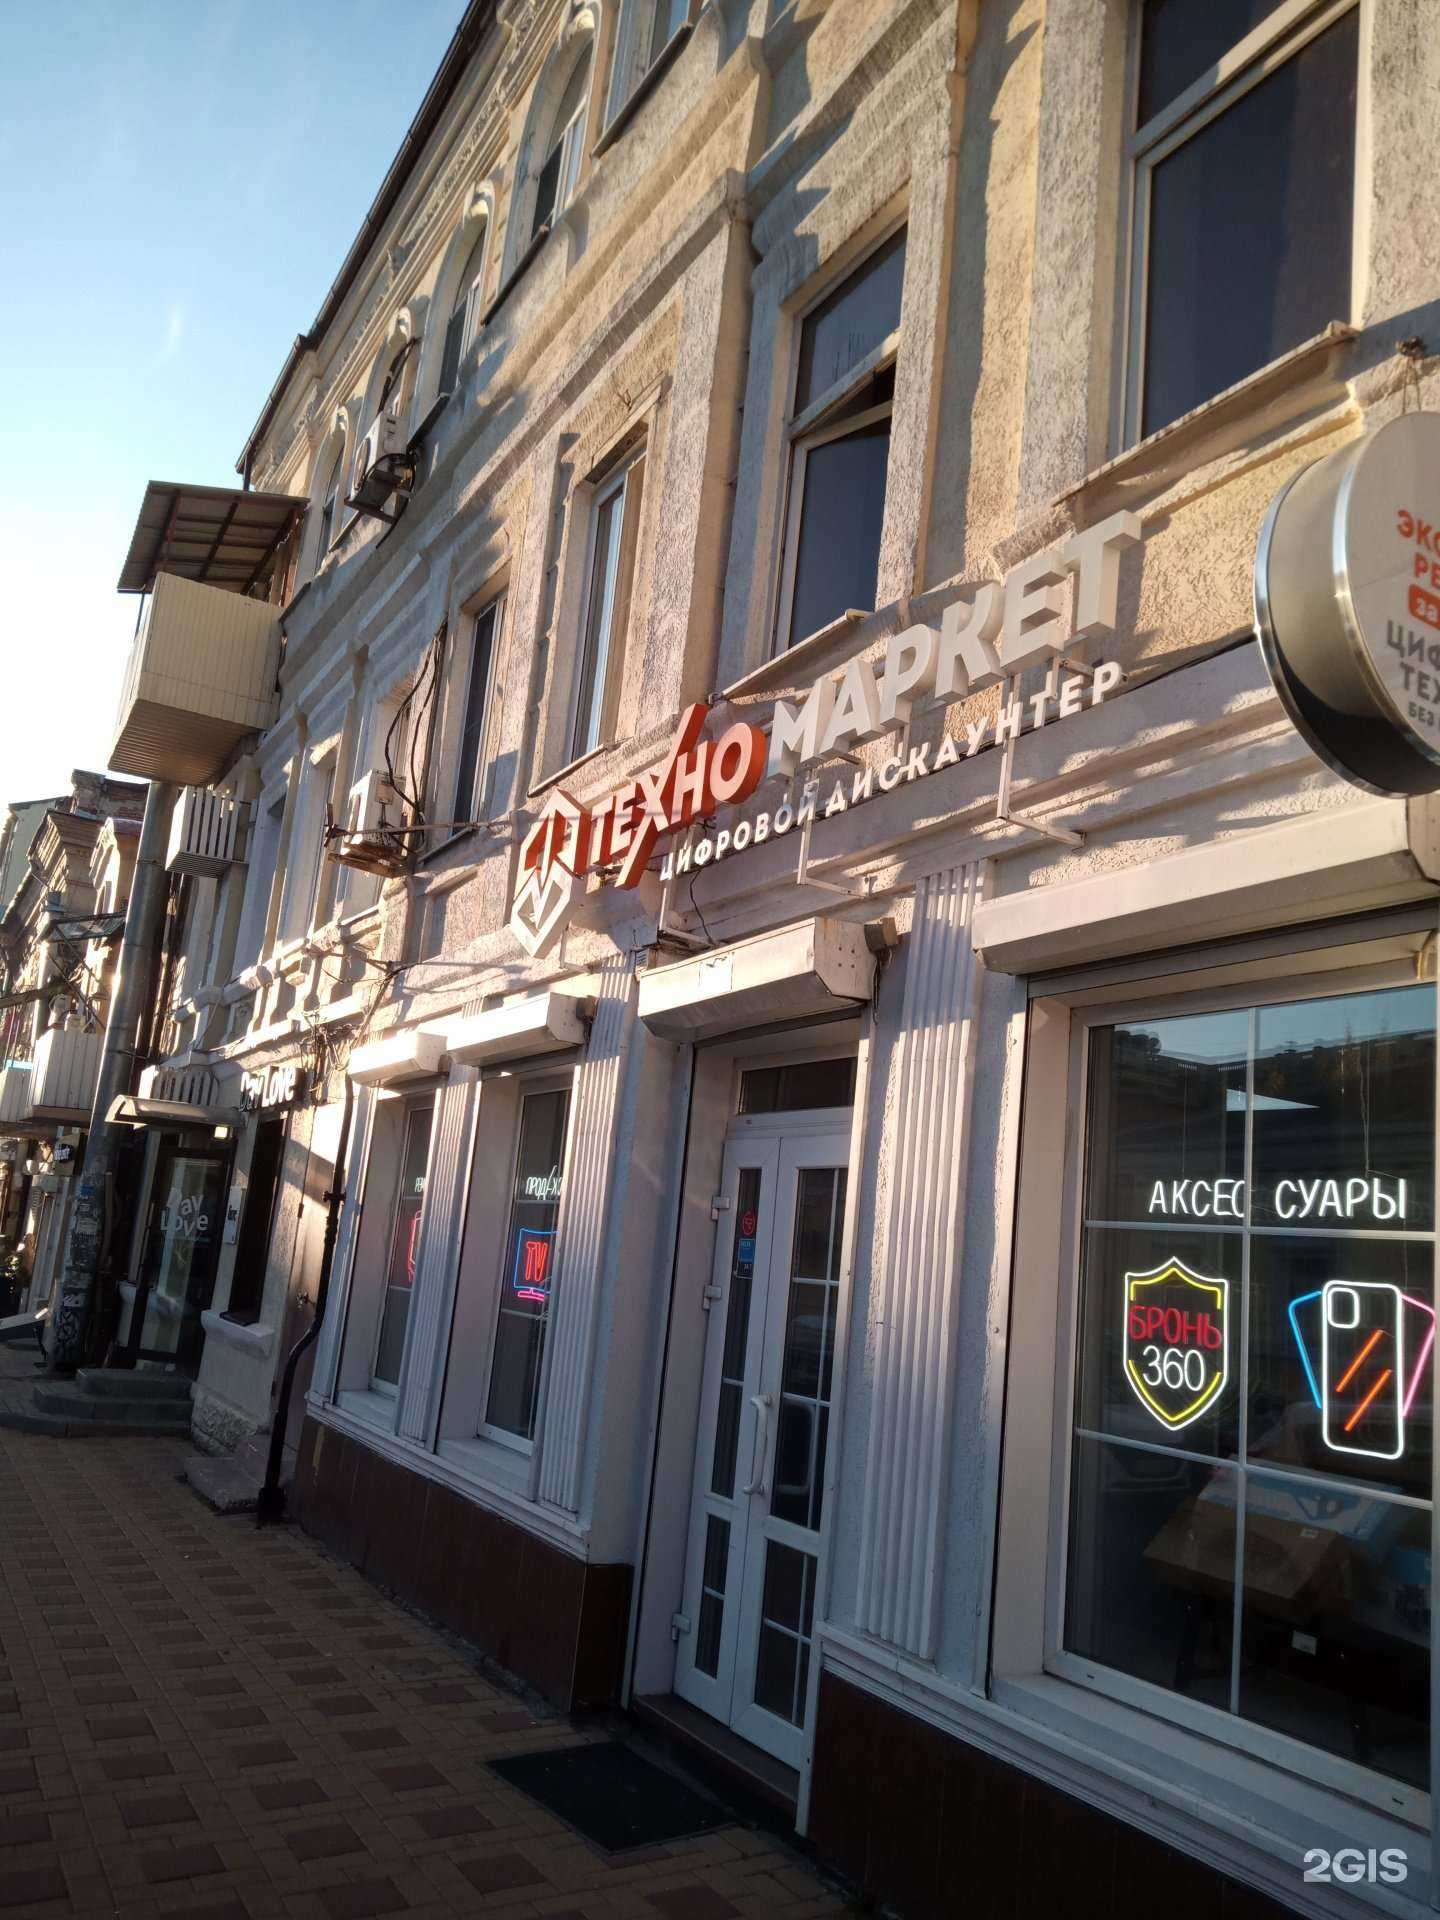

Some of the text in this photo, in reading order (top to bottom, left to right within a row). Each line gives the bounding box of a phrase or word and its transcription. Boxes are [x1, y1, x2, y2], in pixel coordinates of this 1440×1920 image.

[659, 661, 1123, 882] ЦИФРОВОЙ ДИСКАУНТЕР
[1127, 1304, 1223, 1351] БРОНЬ
[1142, 1344, 1206, 1393] 360
